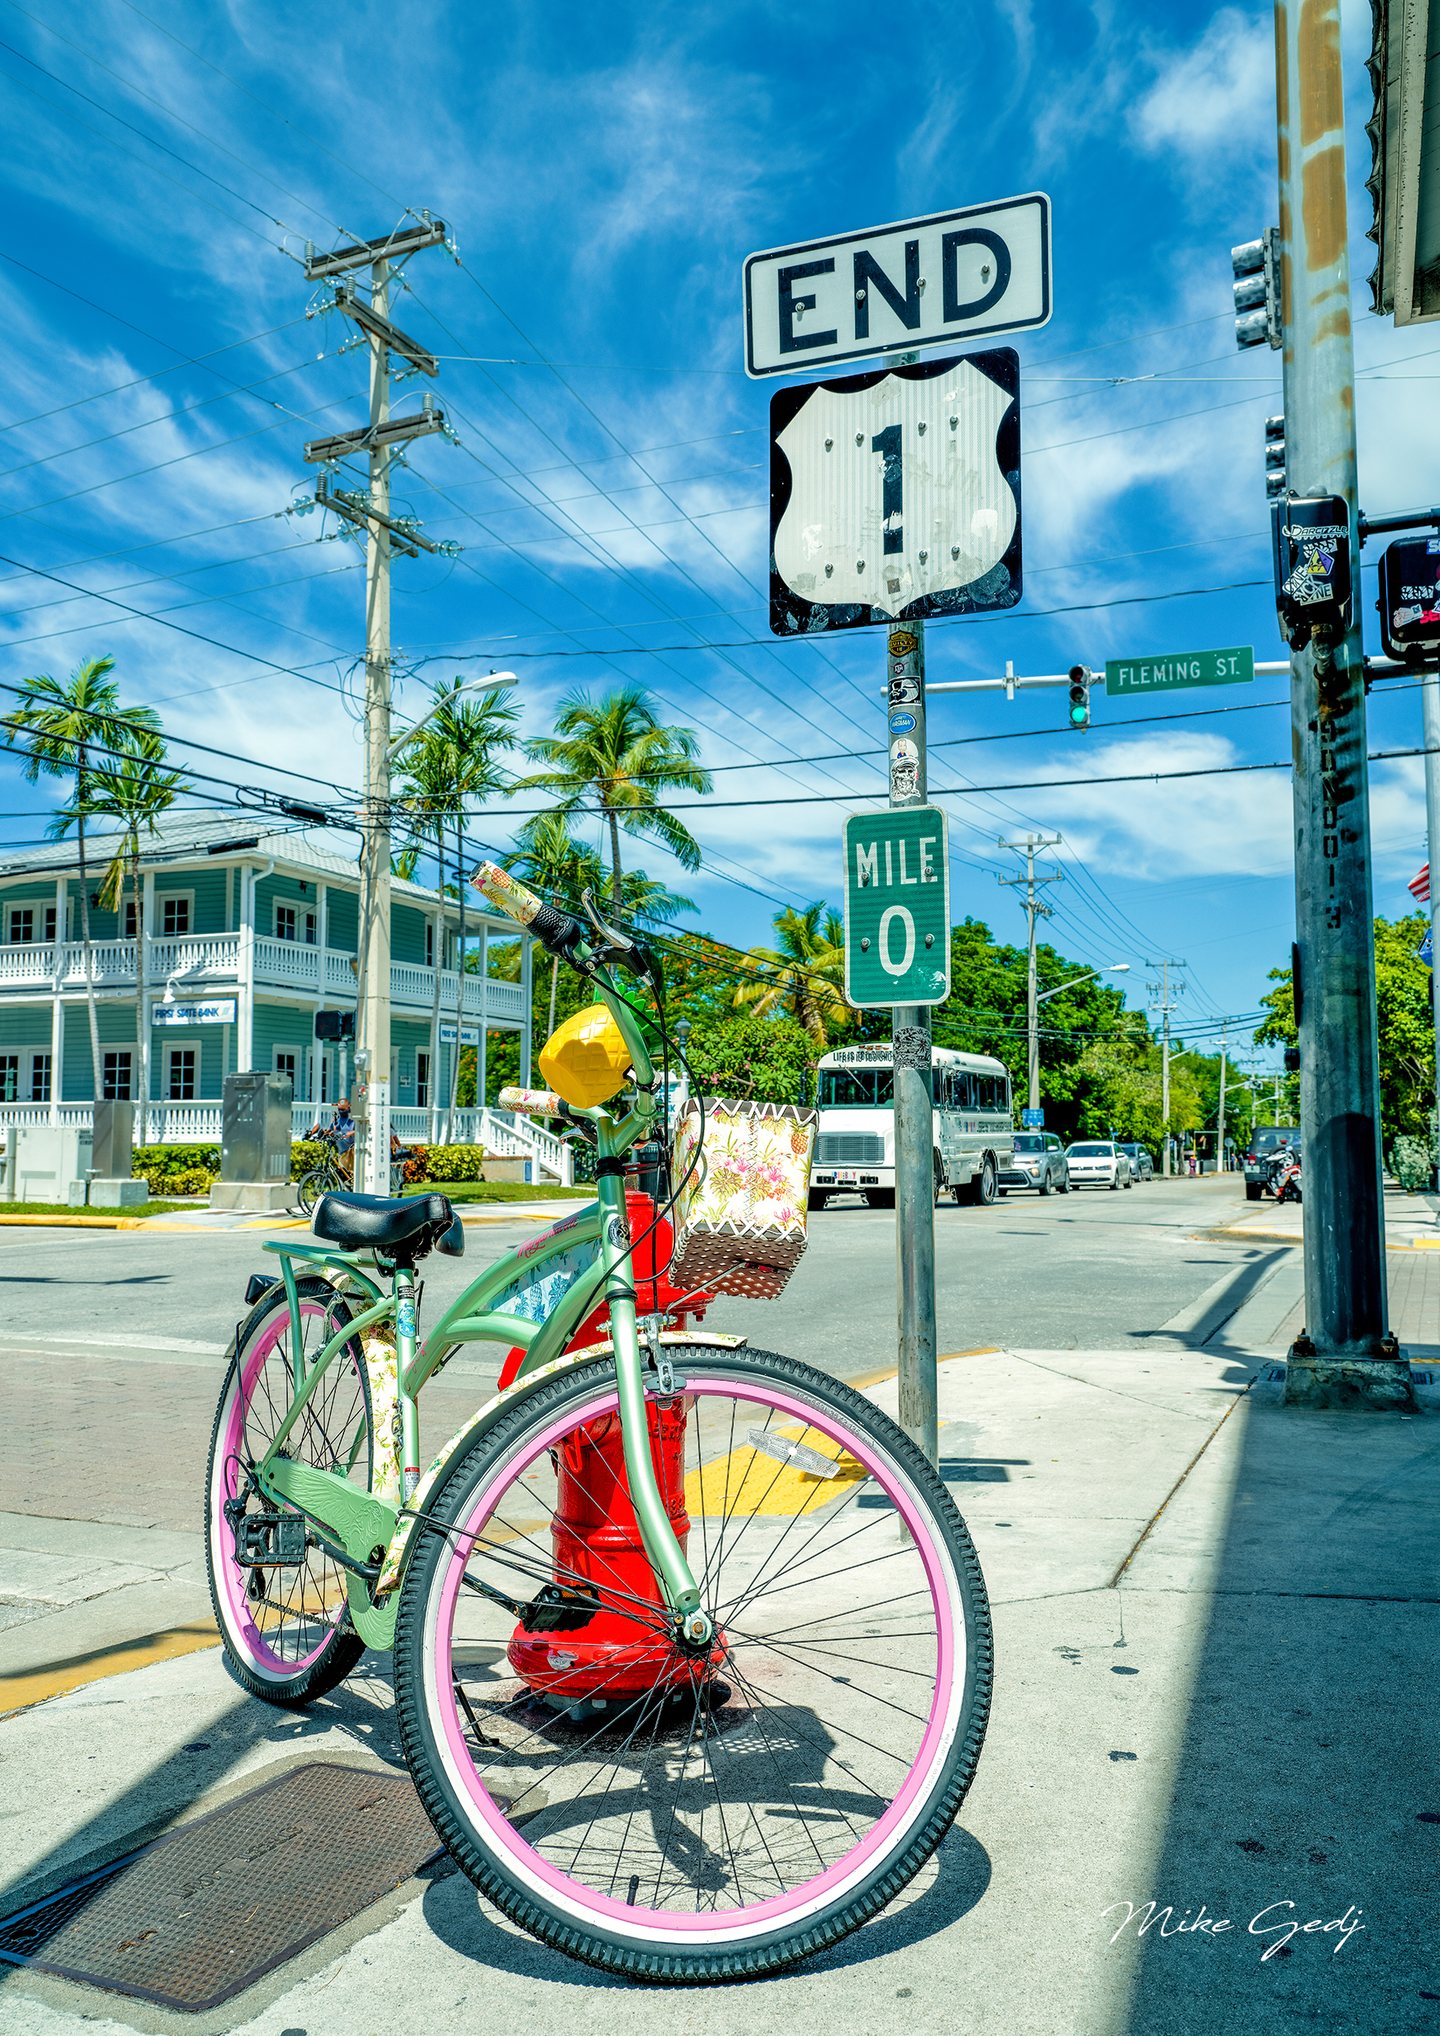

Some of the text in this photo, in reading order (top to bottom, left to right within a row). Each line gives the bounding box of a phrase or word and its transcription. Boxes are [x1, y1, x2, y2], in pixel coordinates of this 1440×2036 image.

[778, 227, 1012, 354] END
[872, 424, 903, 555] 1
[1119, 657, 1240, 686] FLEMING ST.
[856, 836, 938, 888] MILE
[879, 905, 915, 976] 0
[155, 1007, 219, 1018] FIRST STATE BANK
